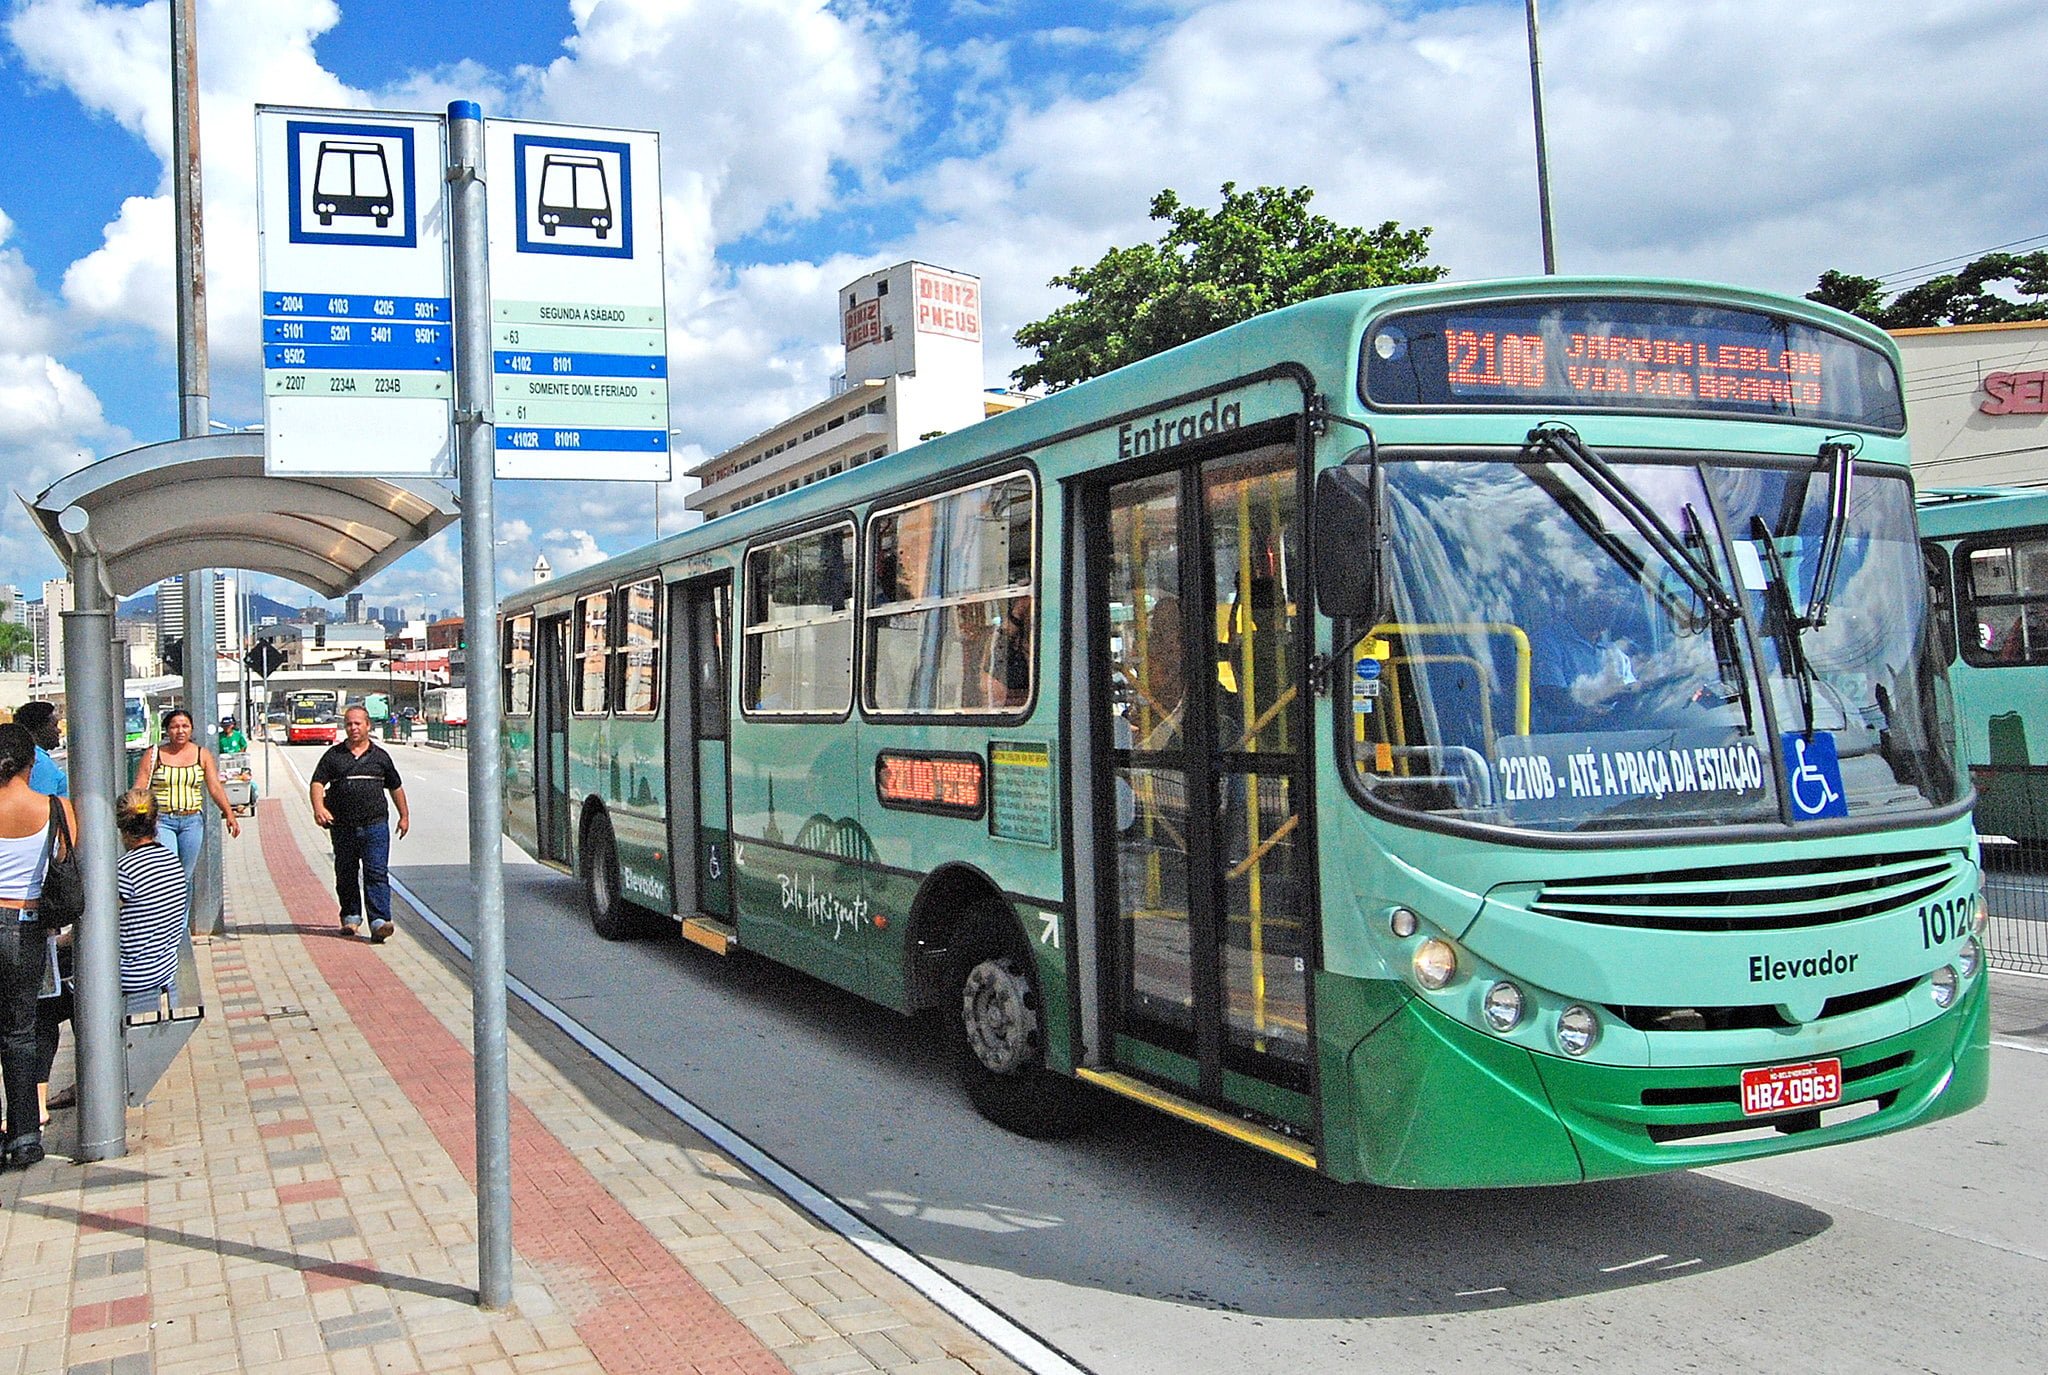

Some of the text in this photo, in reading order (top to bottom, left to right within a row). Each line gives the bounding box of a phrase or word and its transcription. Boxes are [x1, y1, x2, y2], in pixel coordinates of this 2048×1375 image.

[920, 278, 975, 308] DINIZ
[282, 296, 434, 318] 2004 4103 4205 5031
[540, 307, 581, 320] SEGUNDA
[583, 309, 590, 320] A
[919, 304, 977, 333] PNEUS
[283, 323, 435, 344] 5101 5201 5401 9501
[509, 331, 519, 344] 63
[284, 348, 305, 364] 9502
[511, 356, 572, 372] 4102 8101
[1566, 333, 1821, 376] JARDIM LEBLON
[285, 376, 401, 393] 2207 2234A 2234B
[529, 382, 569, 395] SOMENTE
[594, 385, 600, 396] E
[600, 385, 638, 397] FERIADO
[1568, 366, 1821, 404] VIA RIO BRANCO
[1979, 371, 2048, 416] SE
[517, 406, 527, 419] 61
[513, 432, 580, 447] 4102R 8101R
[1118, 398, 1241, 459] Entrada
[1499, 756, 1555, 800] 2210B
[1568, 746, 1602, 797] ATÉ
[1602, 753, 1619, 795] A
[1615, 750, 1673, 800] PRAÇA
[1669, 749, 1698, 792] DA
[1694, 742, 1762, 795] ESTAÇÃO
[625, 866, 665, 900] Elevador
[1749, 949, 1859, 982] Elevador
